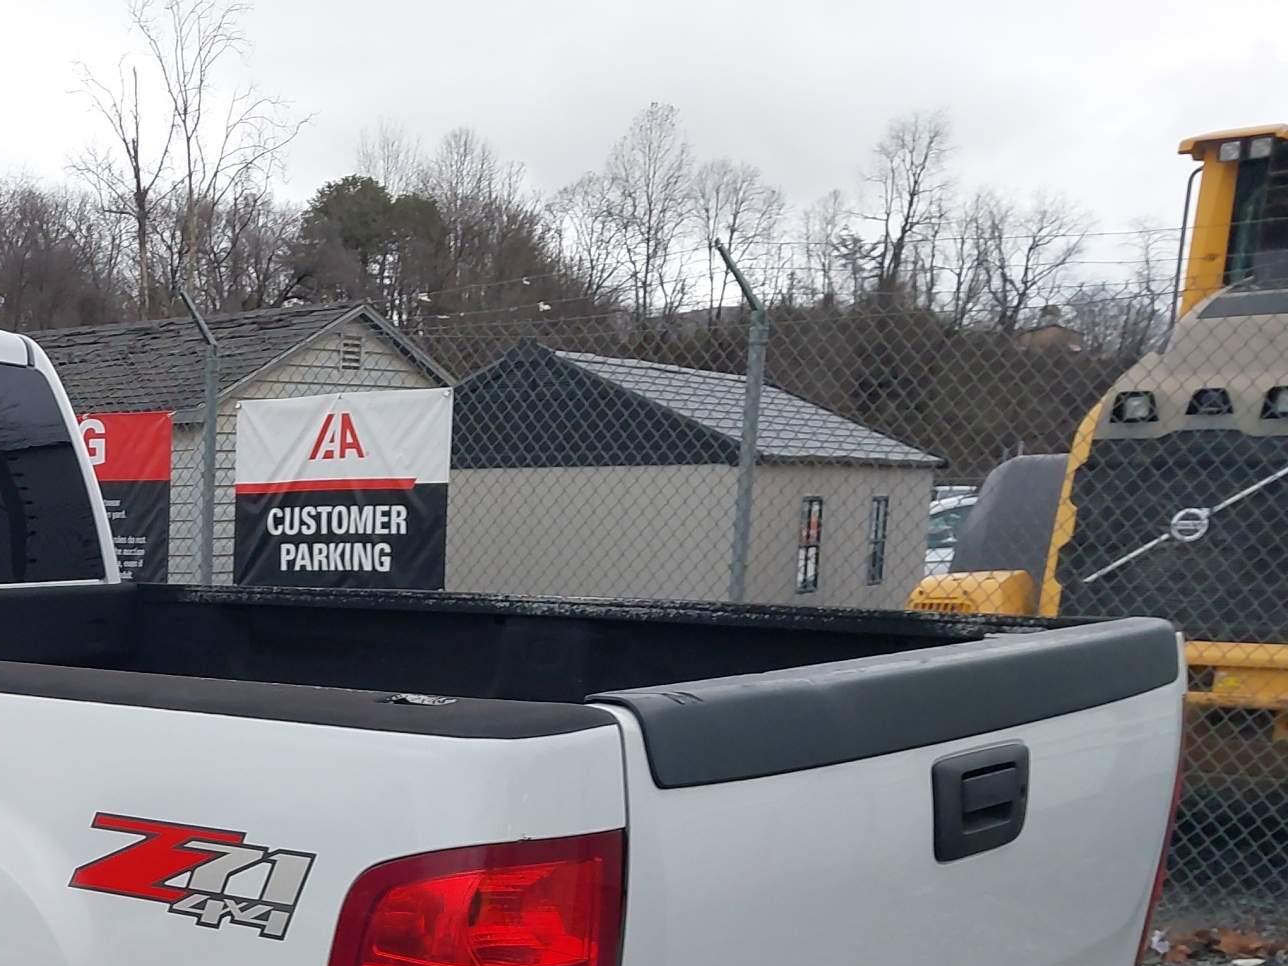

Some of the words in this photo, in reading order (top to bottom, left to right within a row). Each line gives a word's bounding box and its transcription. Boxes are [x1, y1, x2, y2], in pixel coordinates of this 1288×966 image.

[267, 505, 408, 536] CUSTOMER
[280, 542, 392, 573] PARKING
[68, 811, 317, 909] Z71
